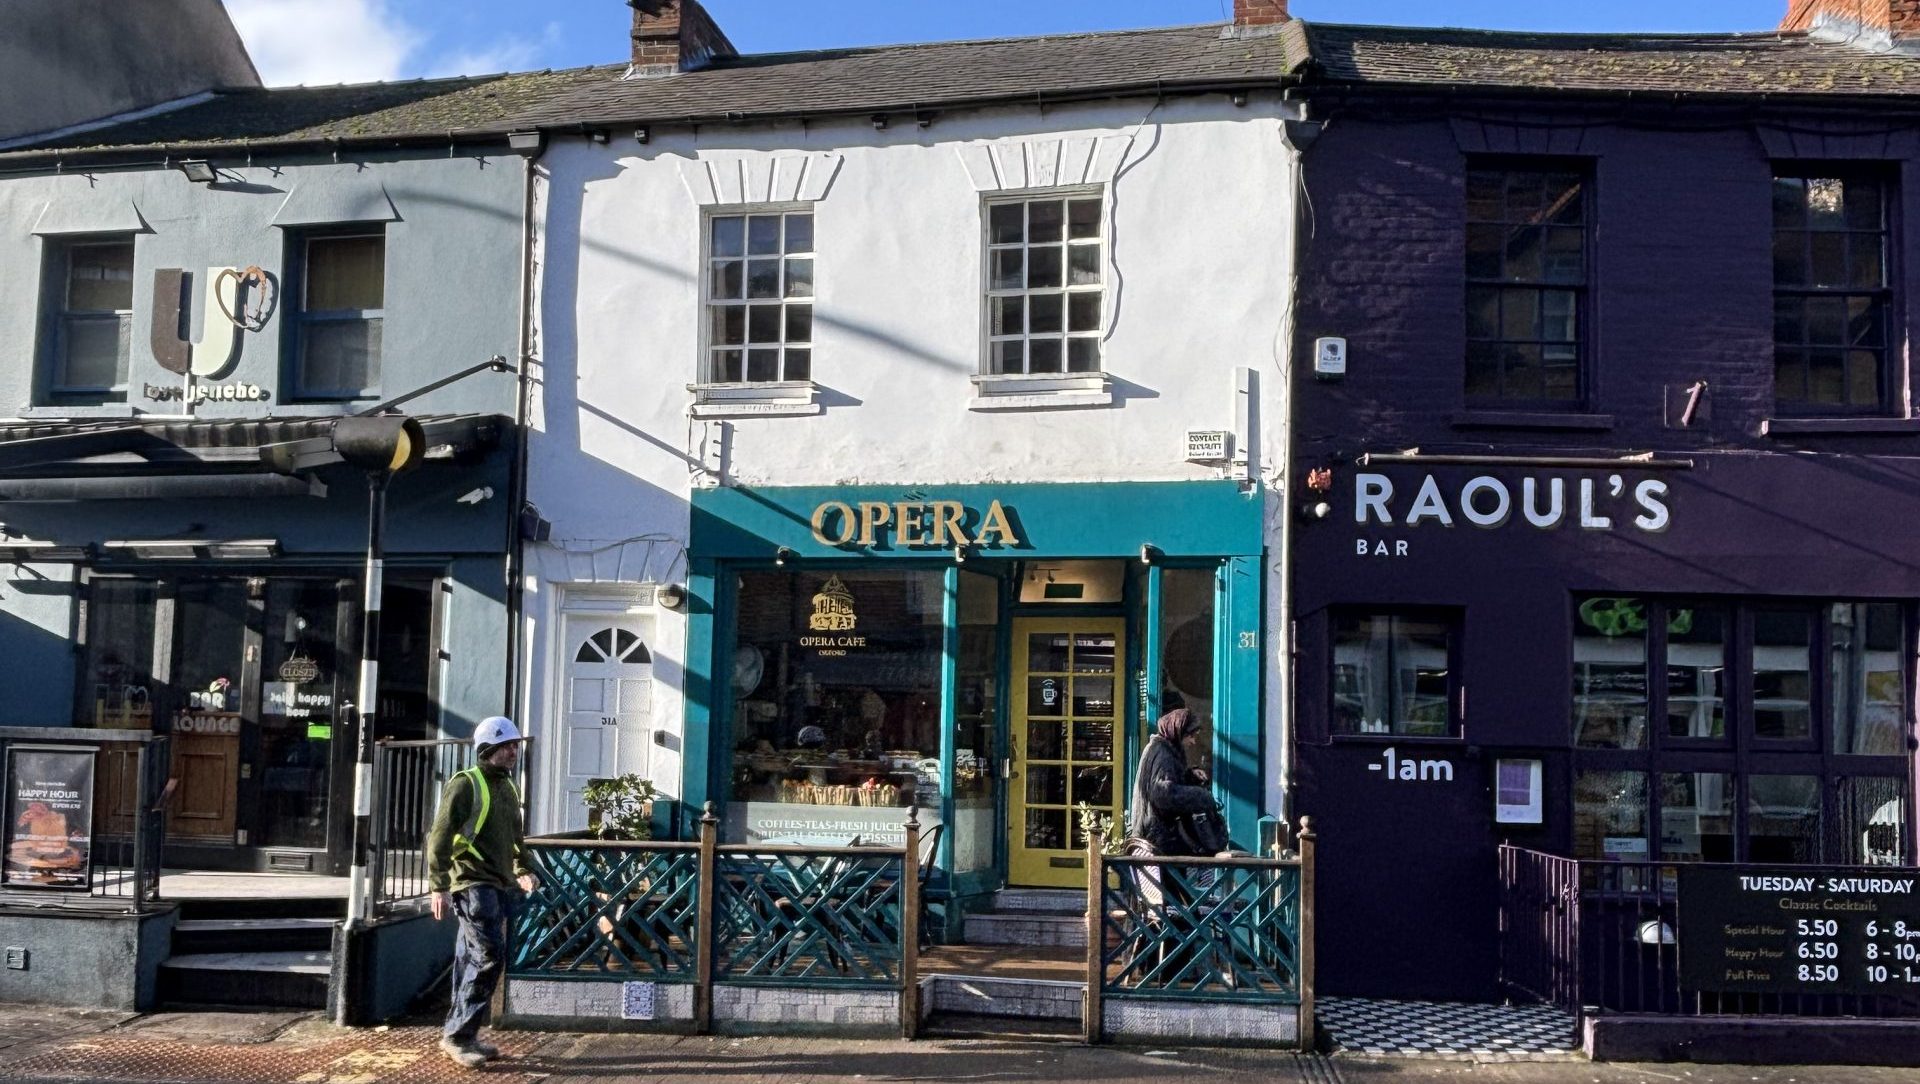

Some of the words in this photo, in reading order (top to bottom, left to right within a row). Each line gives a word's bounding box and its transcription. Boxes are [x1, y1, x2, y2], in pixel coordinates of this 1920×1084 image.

[1189, 434, 1221, 442] CONTACT
[1356, 473, 1669, 530] RAOUL'S
[811, 499, 1019, 546] OPERA
[1356, 539, 1408, 556] BAR
[800, 637, 835, 646] OPERA
[1238, 632, 1256, 648] 31
[298, 692, 331, 706] happy
[18, 789, 48, 798] HAPPY
[49, 790, 79, 799] HOUR
[1740, 876, 1815, 892] TUESDAY
[1828, 878, 1914, 894] SATURDAY
[1779, 898, 1820, 910] Classic
[1823, 898, 1878, 912] Cocktails
[1798, 919, 1838, 936] 5.50
[1866, 920, 1878, 937] 6
[1798, 942, 1838, 959] 6.50
[1866, 943, 1878, 960] 8
[1798, 964, 1838, 981] 8.50
[1866, 965, 1888, 982] 10
